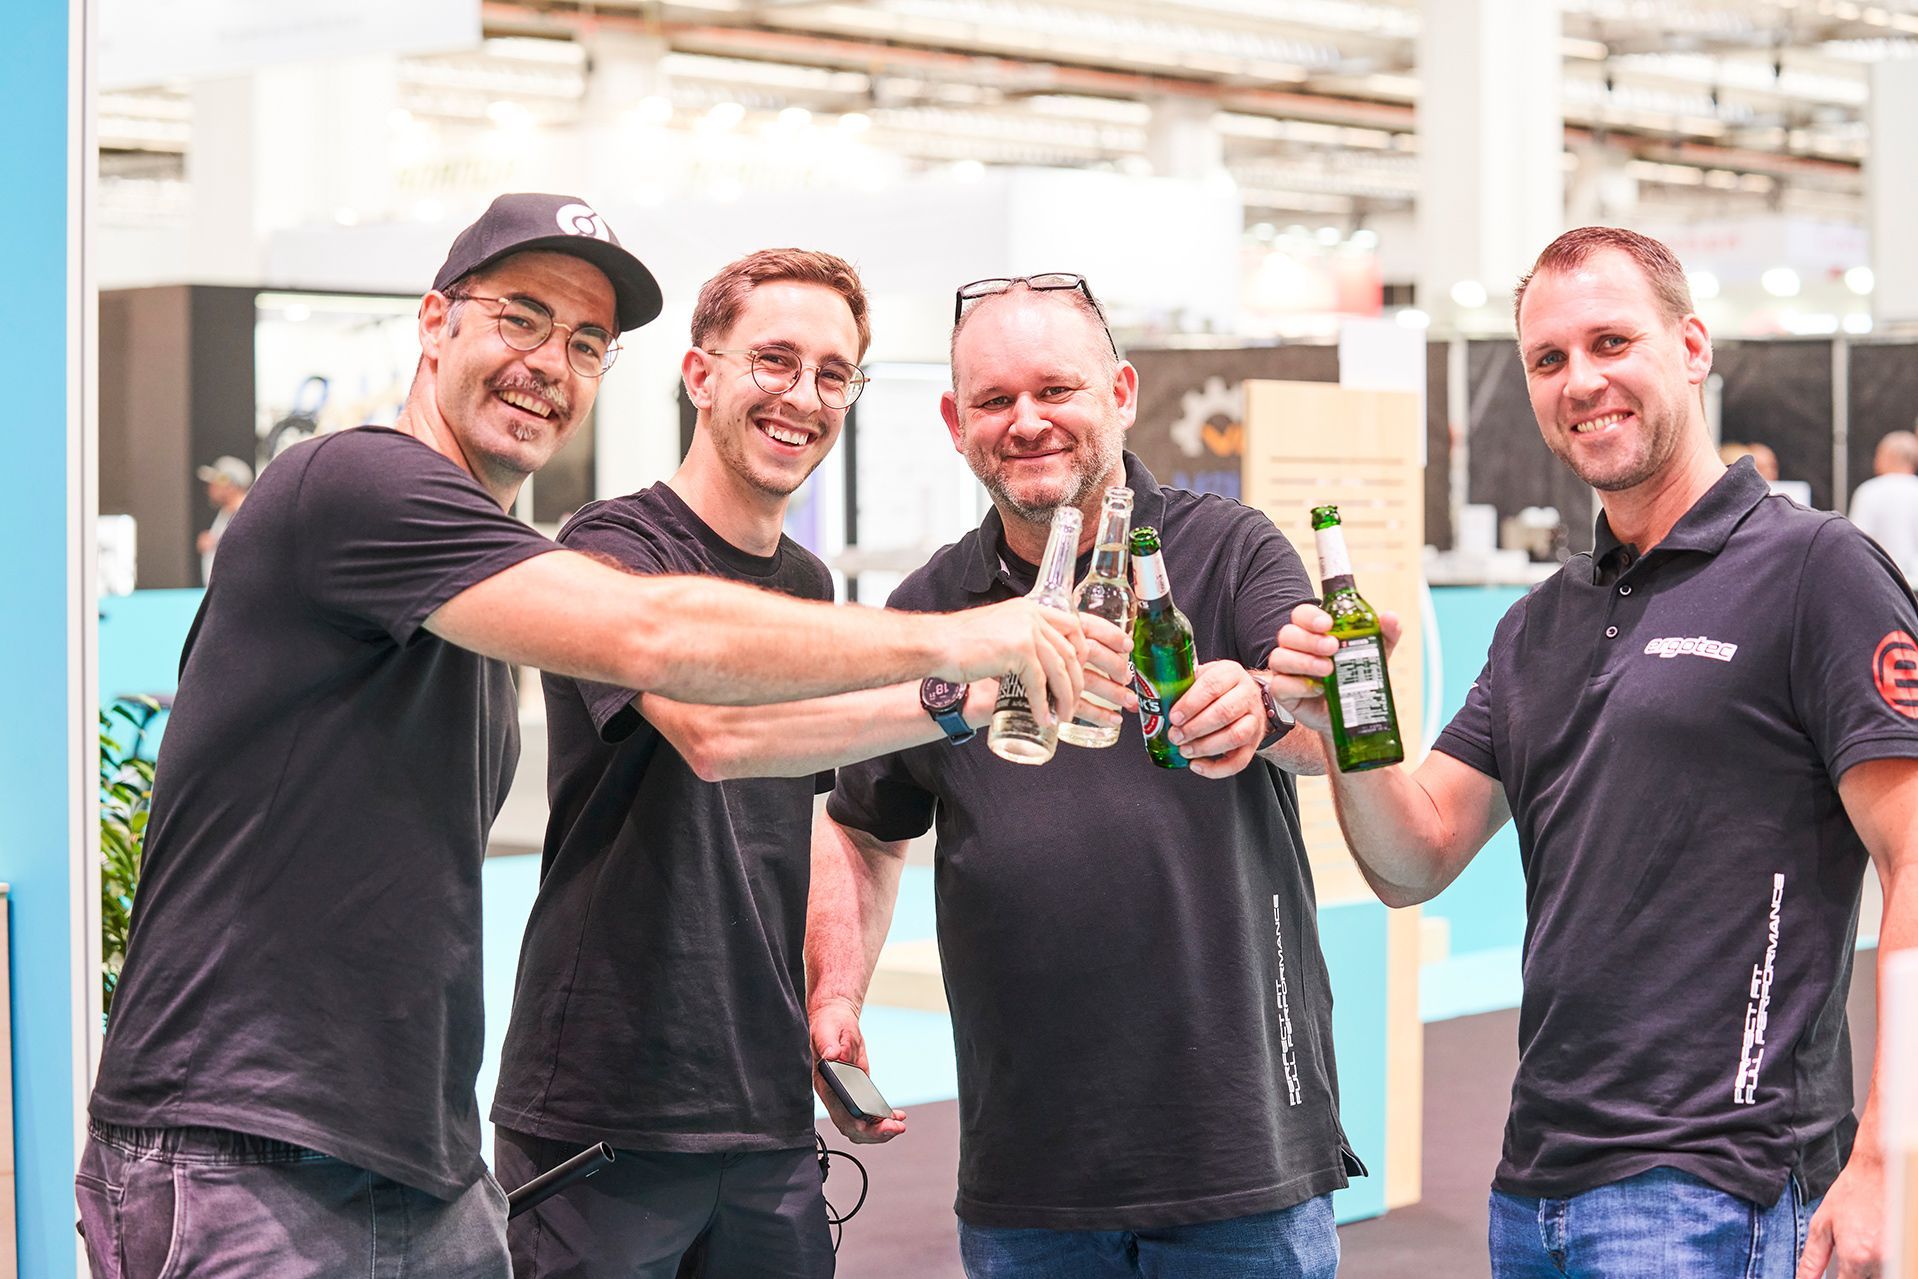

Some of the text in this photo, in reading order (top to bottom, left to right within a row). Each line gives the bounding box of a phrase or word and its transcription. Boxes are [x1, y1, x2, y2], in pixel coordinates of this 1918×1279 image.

[1139, 697, 1160, 713] K'S
[1644, 636, 1738, 662] ergotec
[1273, 894, 1302, 1105] FULL PERFORMANCE
[1275, 979, 1296, 1106] PERFECT FIT
[1734, 963, 1762, 1104] PERFECT FIT
[1745, 872, 1785, 1104] FULL PERFORMANCE
